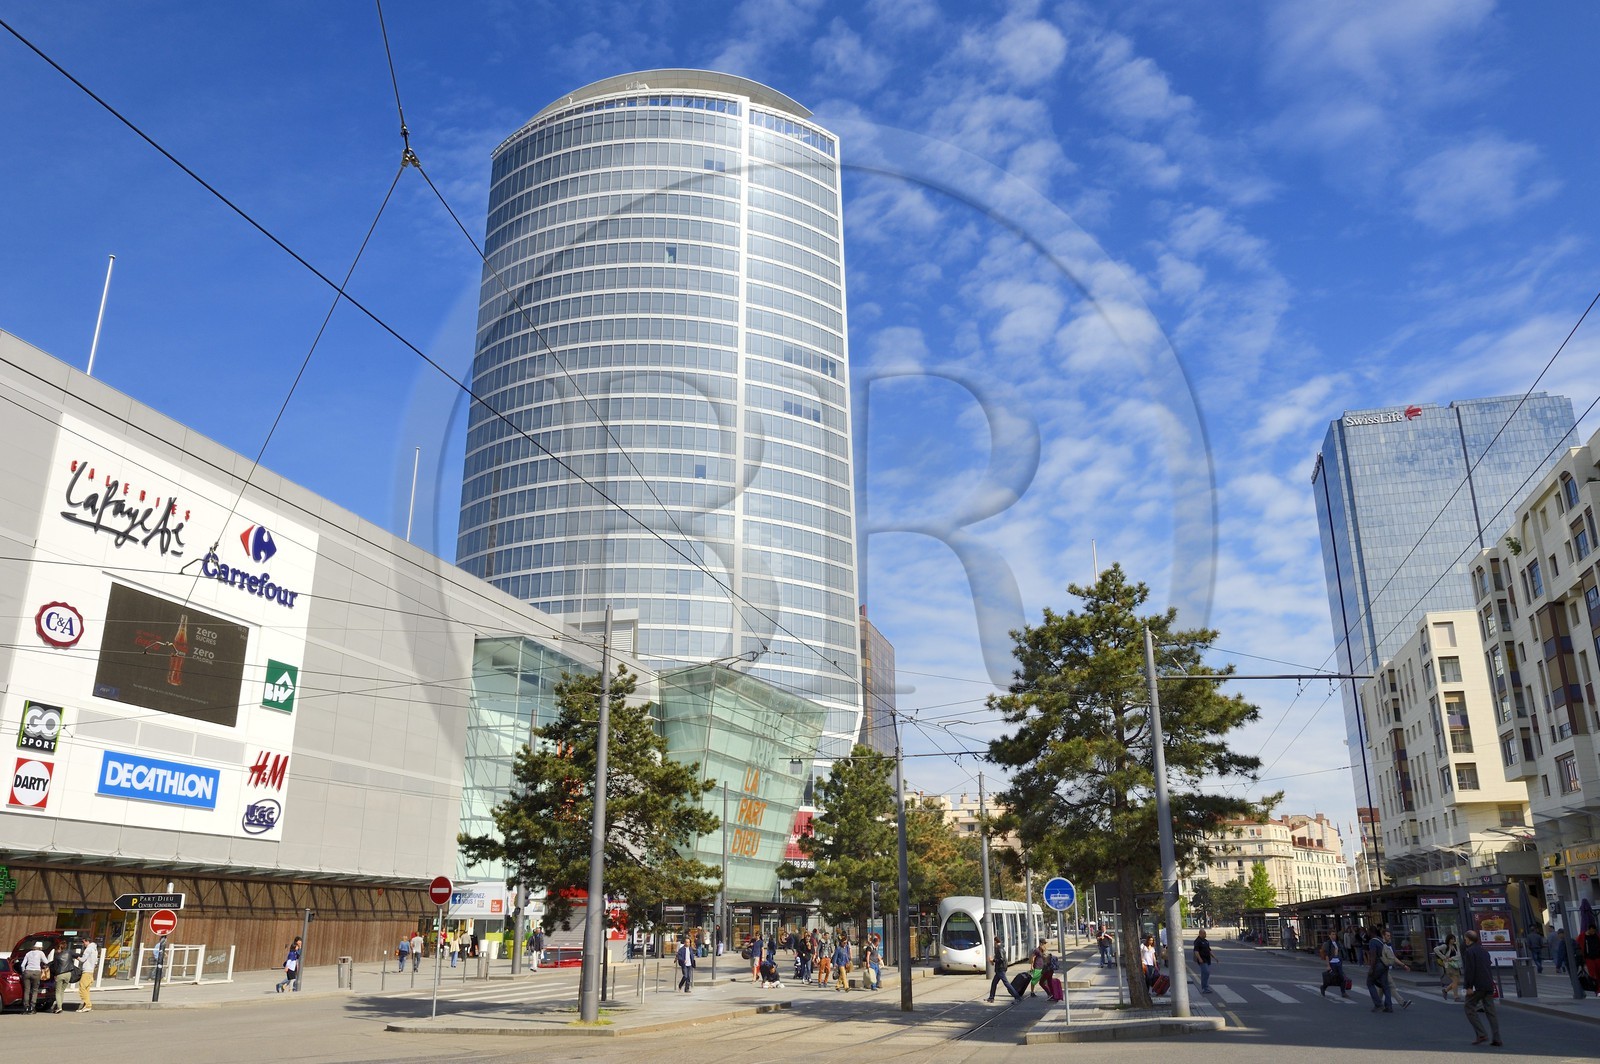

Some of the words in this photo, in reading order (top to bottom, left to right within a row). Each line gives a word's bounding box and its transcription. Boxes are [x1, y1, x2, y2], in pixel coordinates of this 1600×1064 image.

[70, 460, 190, 522] GALERIES
[203, 552, 298, 609] Carrefour
[46, 611, 75, 636] C&A
[196, 627, 218, 639] zero
[195, 634, 217, 646] SUCRES
[193, 647, 215, 660] zero
[264, 682, 294, 704] BHV
[24, 708, 61, 738] GO
[21, 737, 56, 750] SPORT
[13, 774, 49, 792] DARTY
[104, 760, 215, 800] DECATHLON
[248, 751, 289, 791] H&M
[744, 767, 760, 796] LA
[246, 805, 275, 828] UGC
[737, 798, 768, 827] PART
[731, 829, 762, 857] DIEU
[131, 897, 138, 906] P
